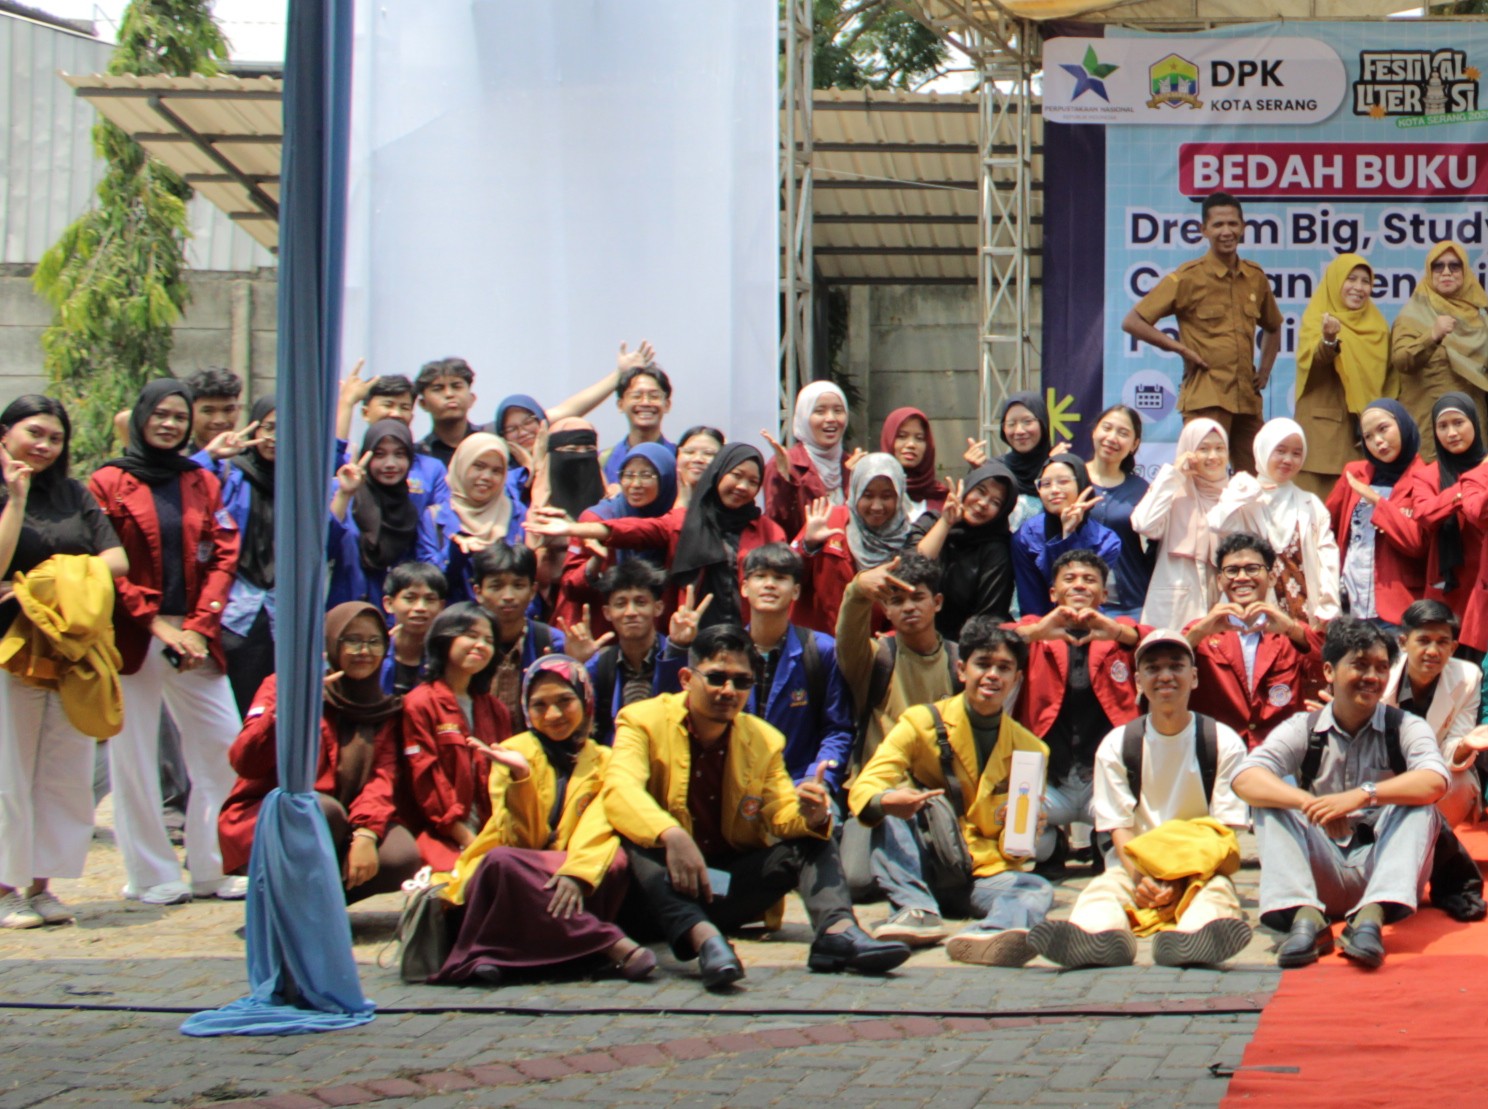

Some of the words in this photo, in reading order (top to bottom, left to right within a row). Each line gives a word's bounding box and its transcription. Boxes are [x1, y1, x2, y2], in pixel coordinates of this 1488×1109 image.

[1211, 59, 1284, 87] DPK
[1362, 52, 1466, 81] FESTIVAL
[1210, 99, 1253, 112] KOTA
[1256, 99, 1318, 112] SERANG
[1356, 83, 1476, 113] LITERSI
[1193, 154, 1343, 189] BEDAH
[1355, 154, 1477, 189] BUKU
[1131, 213, 1279, 245] Drem
[1292, 209, 1371, 254] Big,
